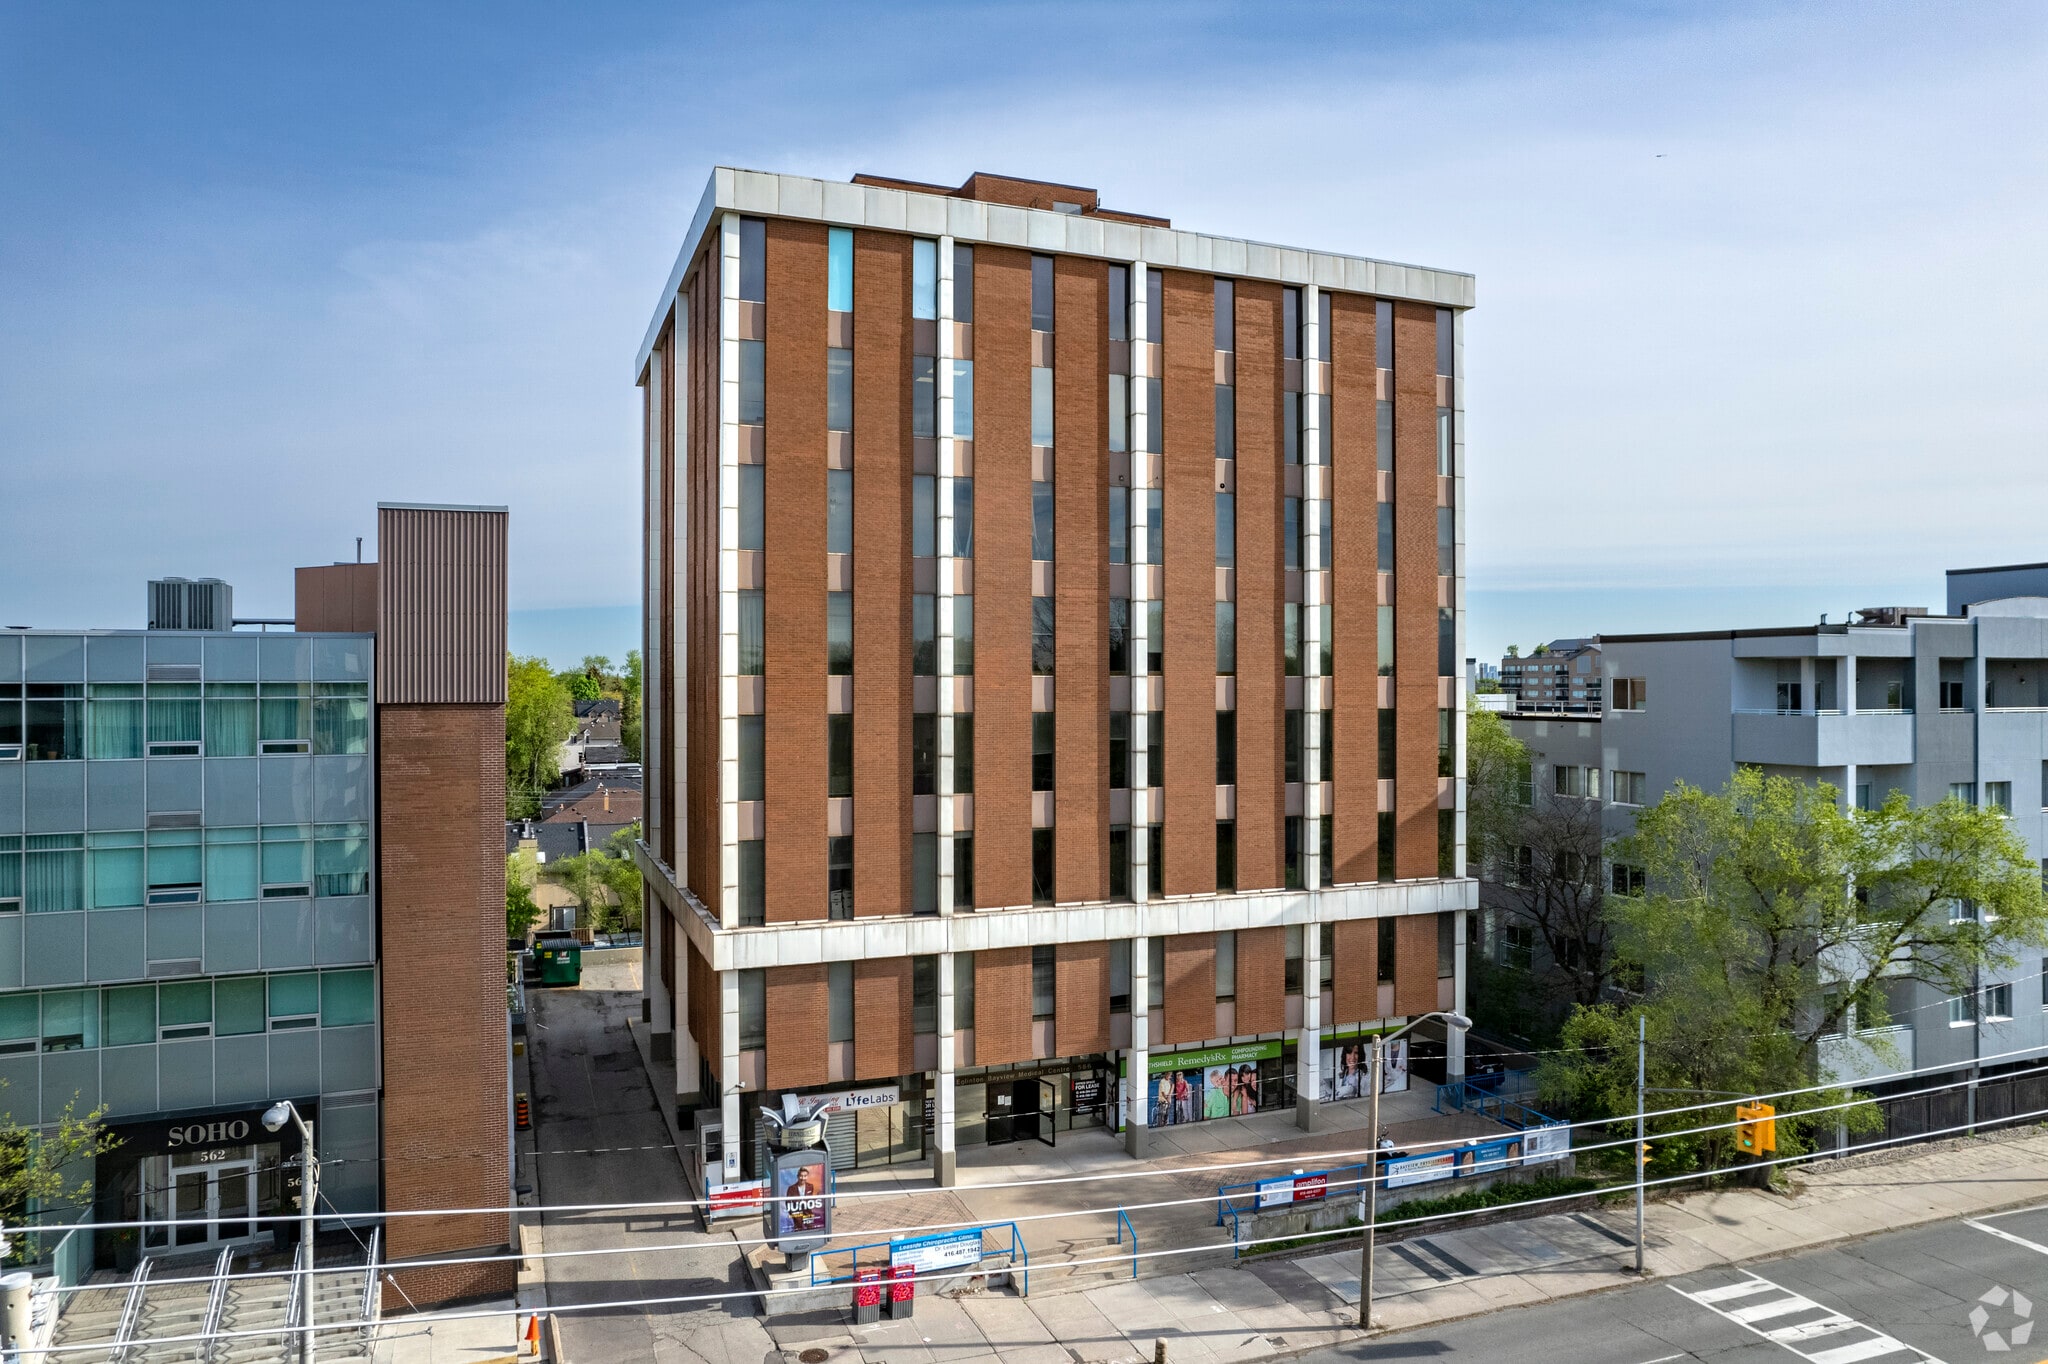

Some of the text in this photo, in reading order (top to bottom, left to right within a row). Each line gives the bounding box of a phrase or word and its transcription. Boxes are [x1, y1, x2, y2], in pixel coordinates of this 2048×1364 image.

[1231, 1045, 1267, 1054] COMPOUNDING
[1231, 1052, 1258, 1061] PHARMACY
[956, 1077, 984, 1087] Eglinton
[987, 1073, 1015, 1082] Bayview
[1018, 1069, 1044, 1078] Medical
[1048, 1066, 1071, 1074] Centre
[1086, 1082, 1100, 1090] LEASE
[845, 1092, 894, 1107] LifeLabs
[168, 1119, 249, 1147] SOHO
[200, 1149, 226, 1163] 562
[287, 1178, 303, 1188] 56
[1296, 1177, 1326, 1189] amplifon
[899, 1243, 922, 1251] Leaside
[923, 1236, 957, 1247] Chiropractic
[958, 1233, 975, 1241] Clinic
